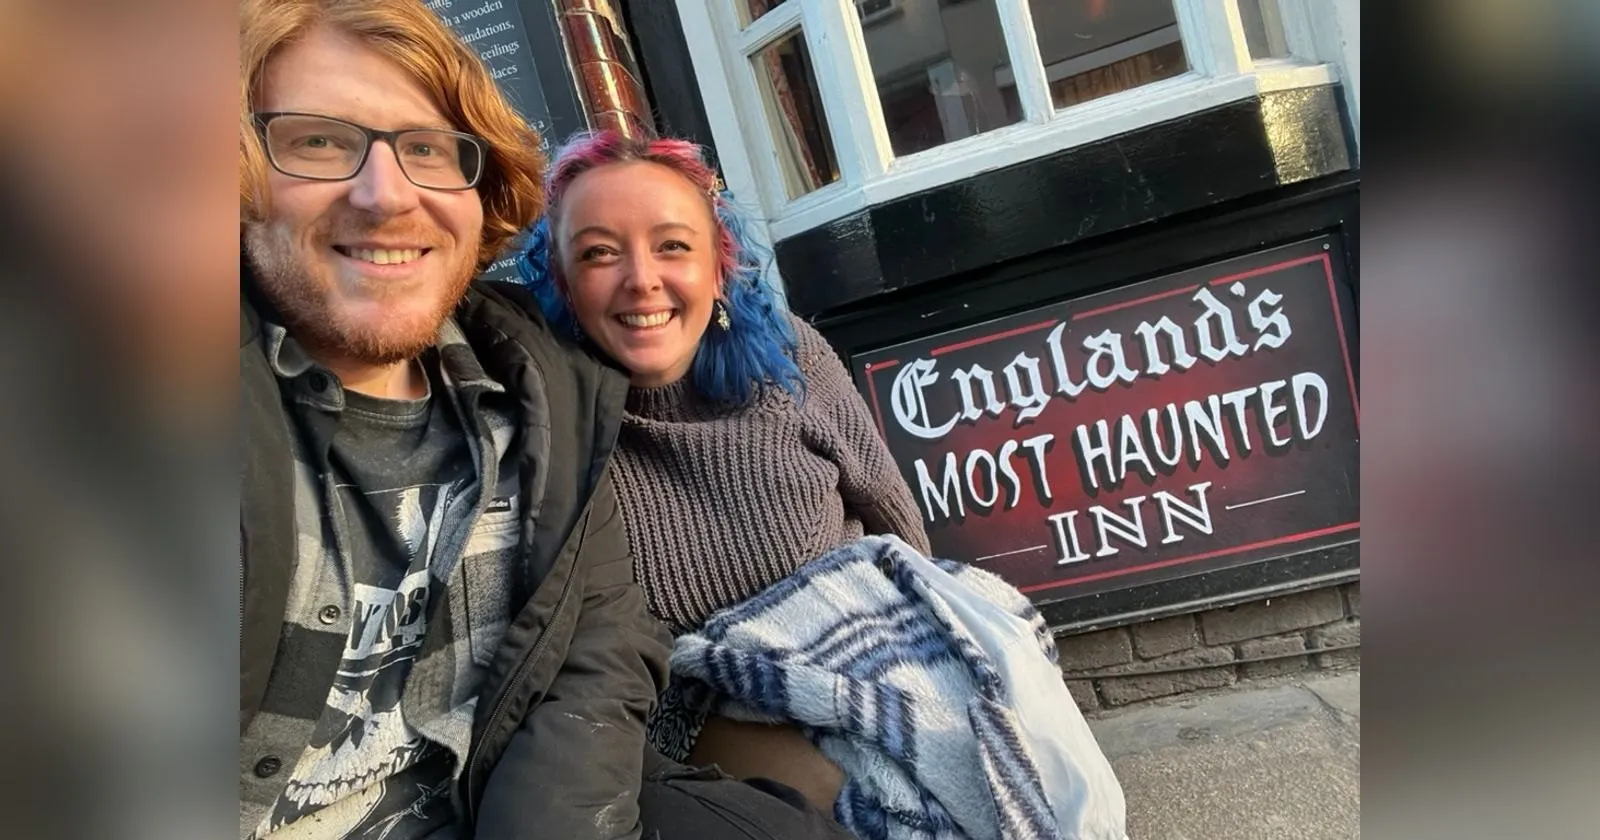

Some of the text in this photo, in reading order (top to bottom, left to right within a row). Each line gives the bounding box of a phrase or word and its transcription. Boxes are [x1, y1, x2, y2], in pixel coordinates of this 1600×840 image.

[454, 16, 460, 24] a
[461, 0, 503, 20] wooden
[481, 41, 520, 60] ceilings
[891, 281, 1292, 439] England's
[914, 372, 1328, 523] MOST HAUNTED
[1048, 481, 1213, 566] INN
